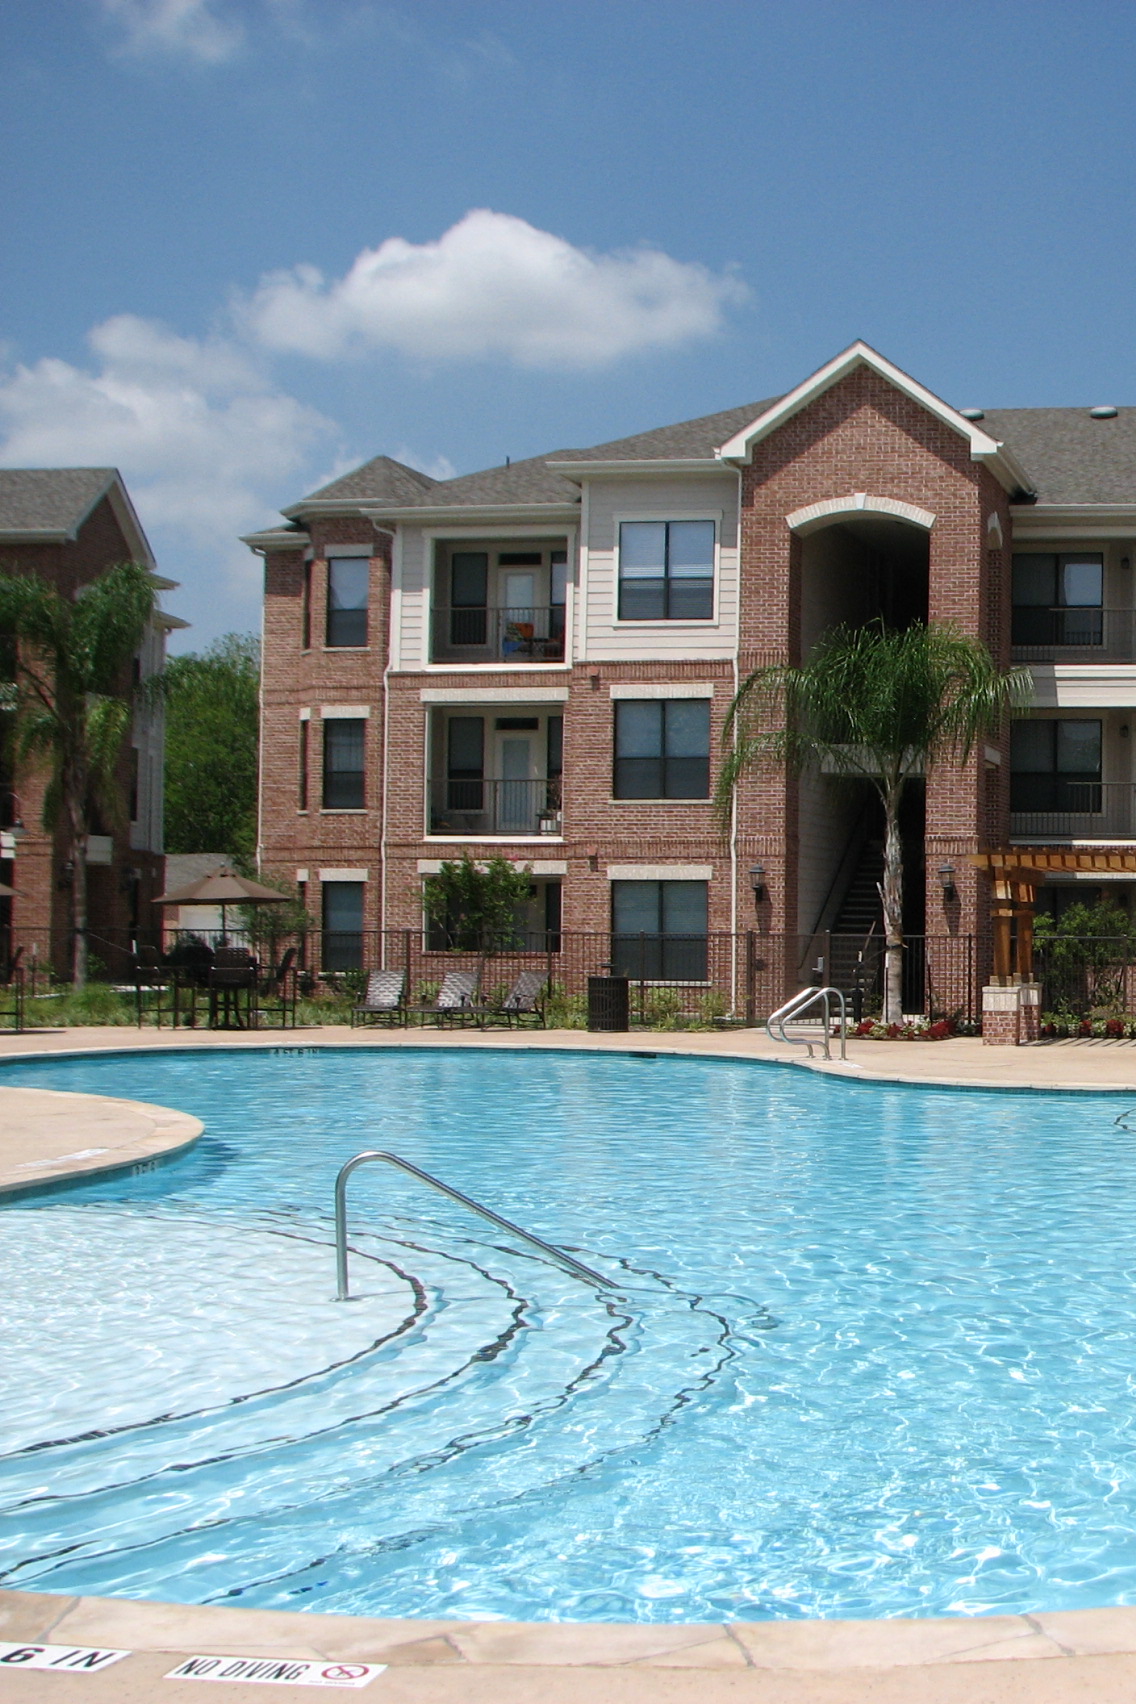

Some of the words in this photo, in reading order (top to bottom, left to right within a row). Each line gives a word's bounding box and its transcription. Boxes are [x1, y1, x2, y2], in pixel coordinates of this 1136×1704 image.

[0, 1647, 45, 1663] 6
[49, 1650, 116, 1667] IN
[174, 1658, 222, 1676] NO
[218, 1660, 311, 1680] DIVING
